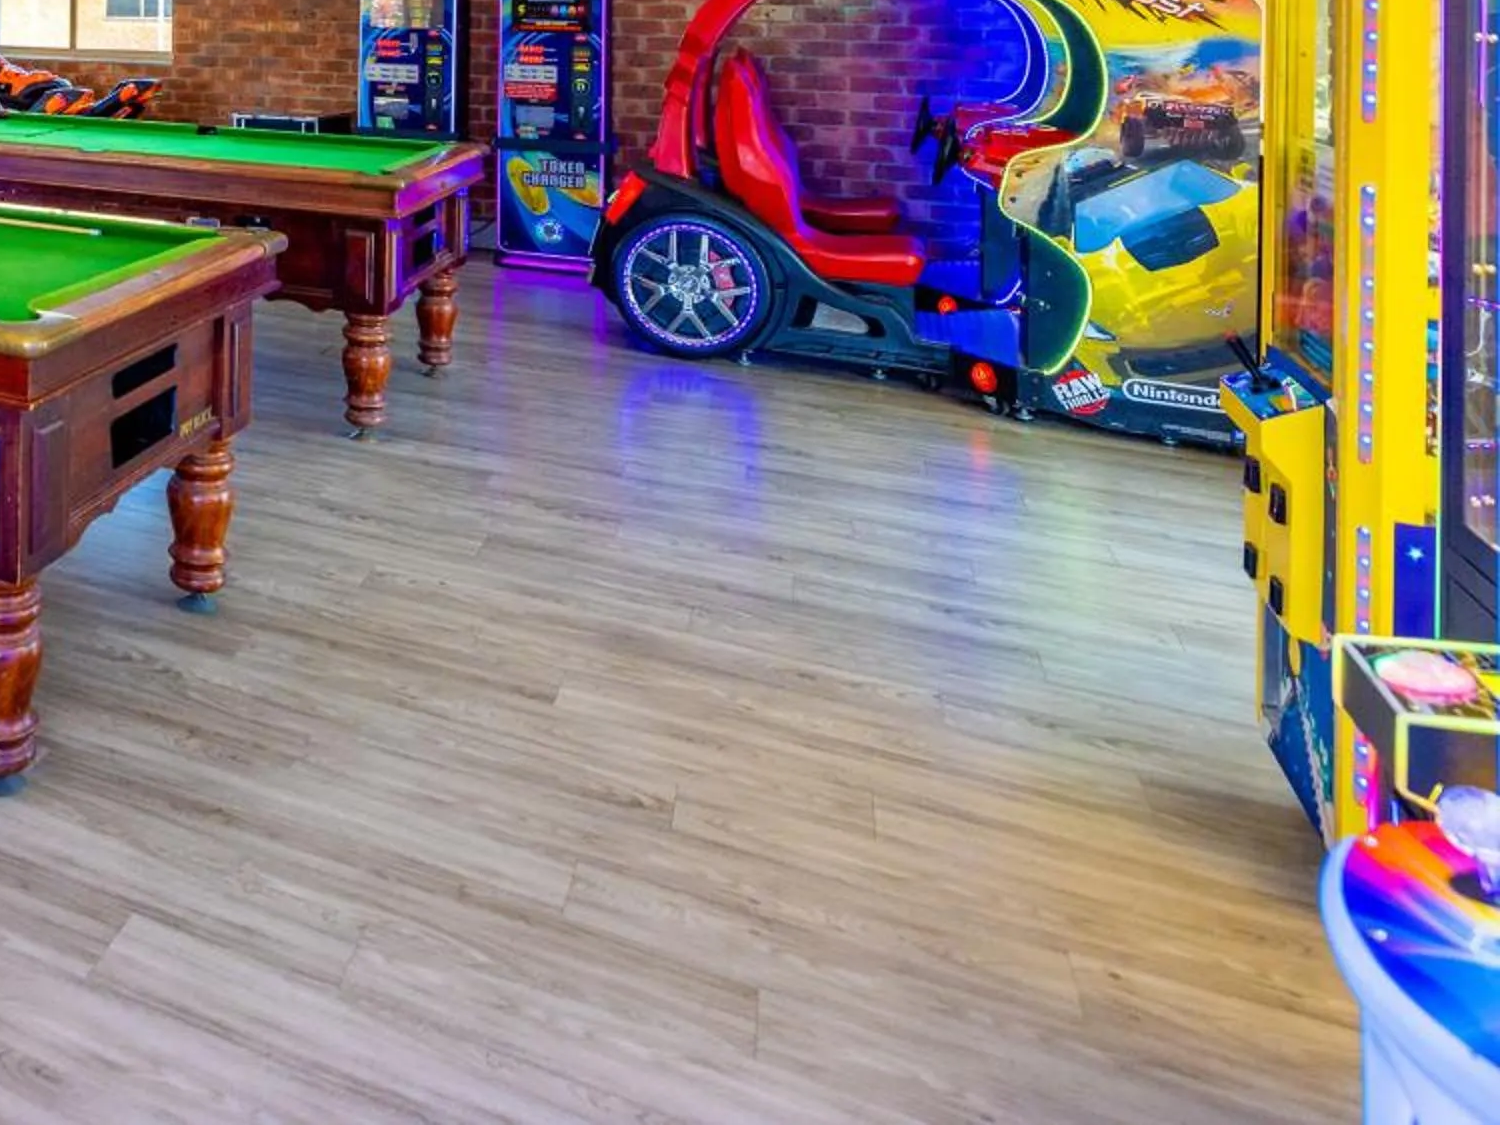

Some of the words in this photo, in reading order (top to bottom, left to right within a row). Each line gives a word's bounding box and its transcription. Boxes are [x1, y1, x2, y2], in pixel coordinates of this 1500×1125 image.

[542, 160, 585, 175] TOKEN
[522, 172, 585, 188] CHANGER
[1051, 372, 1103, 400] RAW
[1133, 384, 1221, 408] Nintend
